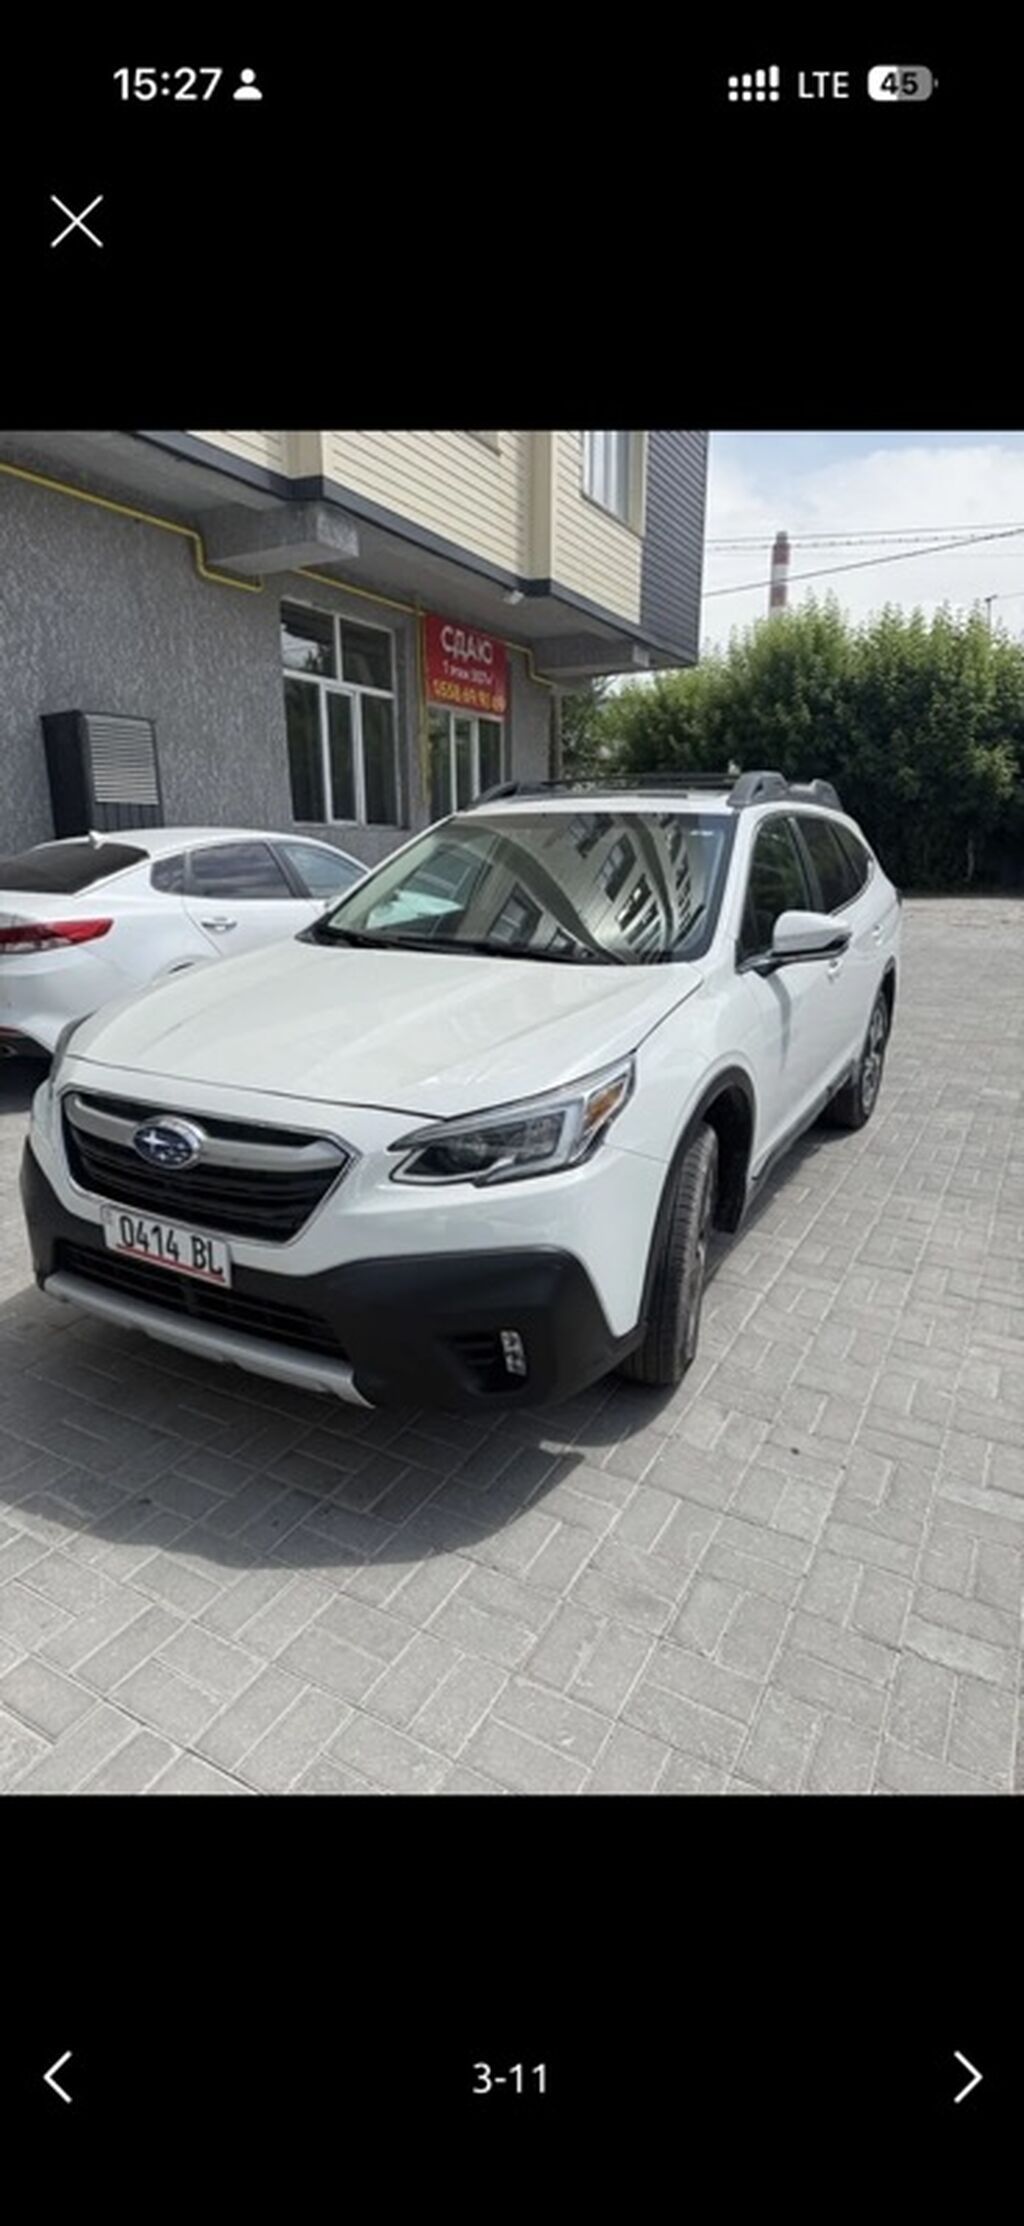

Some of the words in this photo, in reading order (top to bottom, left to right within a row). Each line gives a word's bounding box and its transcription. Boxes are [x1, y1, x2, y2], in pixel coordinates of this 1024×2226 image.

[441, 625, 493, 665] СДАЮ
[119, 1214, 180, 1262] 0414
[190, 1233, 223, 1276] BL
